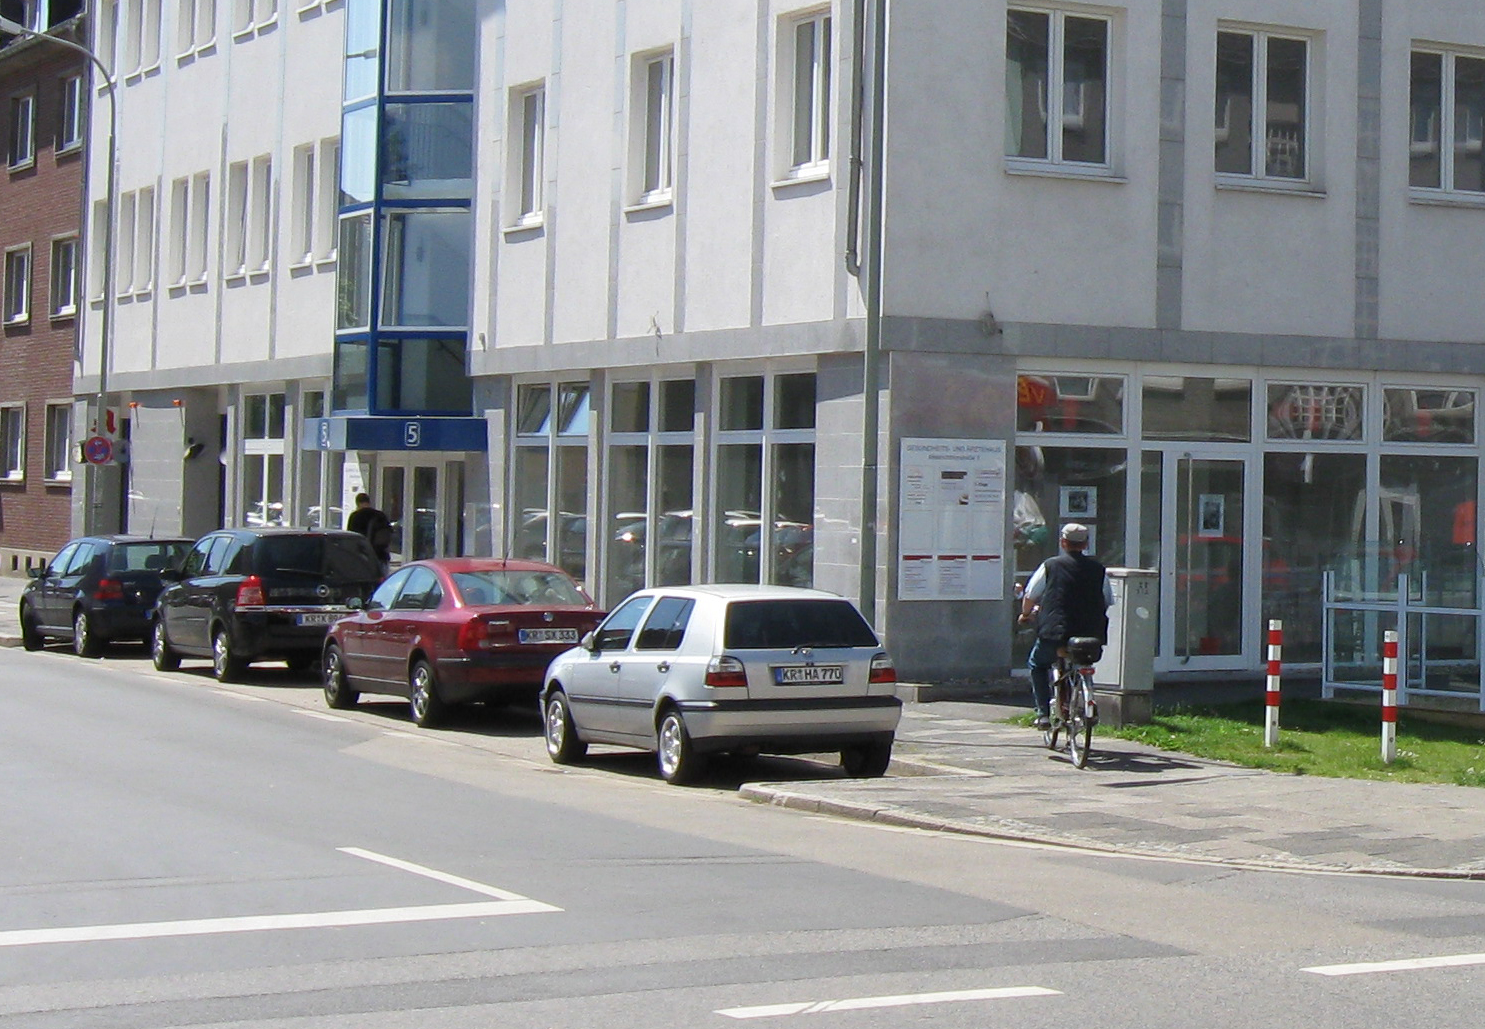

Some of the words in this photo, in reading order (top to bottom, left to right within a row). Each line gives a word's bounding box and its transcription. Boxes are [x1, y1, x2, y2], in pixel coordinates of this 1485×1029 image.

[407, 425, 417, 443] 5
[783, 669, 797, 680] KR
[804, 668, 819, 680] HA
[821, 668, 841, 680] 770
